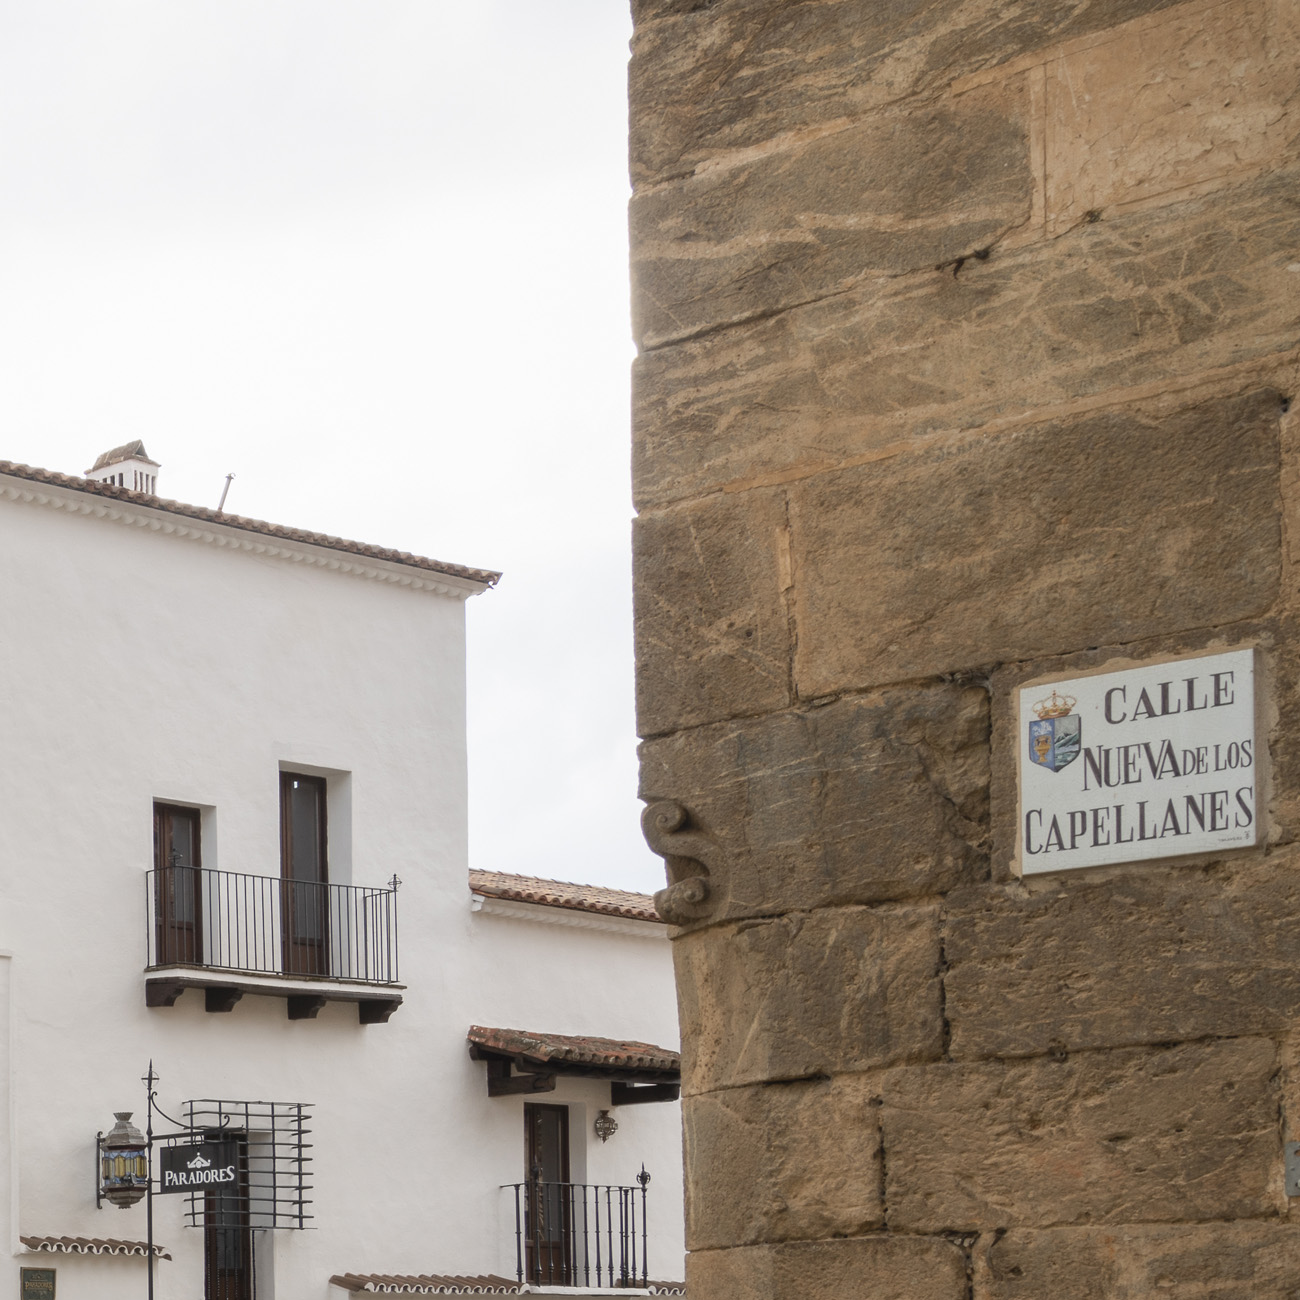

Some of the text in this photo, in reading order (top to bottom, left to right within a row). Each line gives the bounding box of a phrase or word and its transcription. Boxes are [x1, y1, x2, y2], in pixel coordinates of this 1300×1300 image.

[1104, 671, 1235, 725] CALLE
[1081, 739, 1253, 792] NUEVA DE LOS
[1025, 786, 1254, 855] CAPELLANES
[164, 1165, 236, 1187] PARADORES
